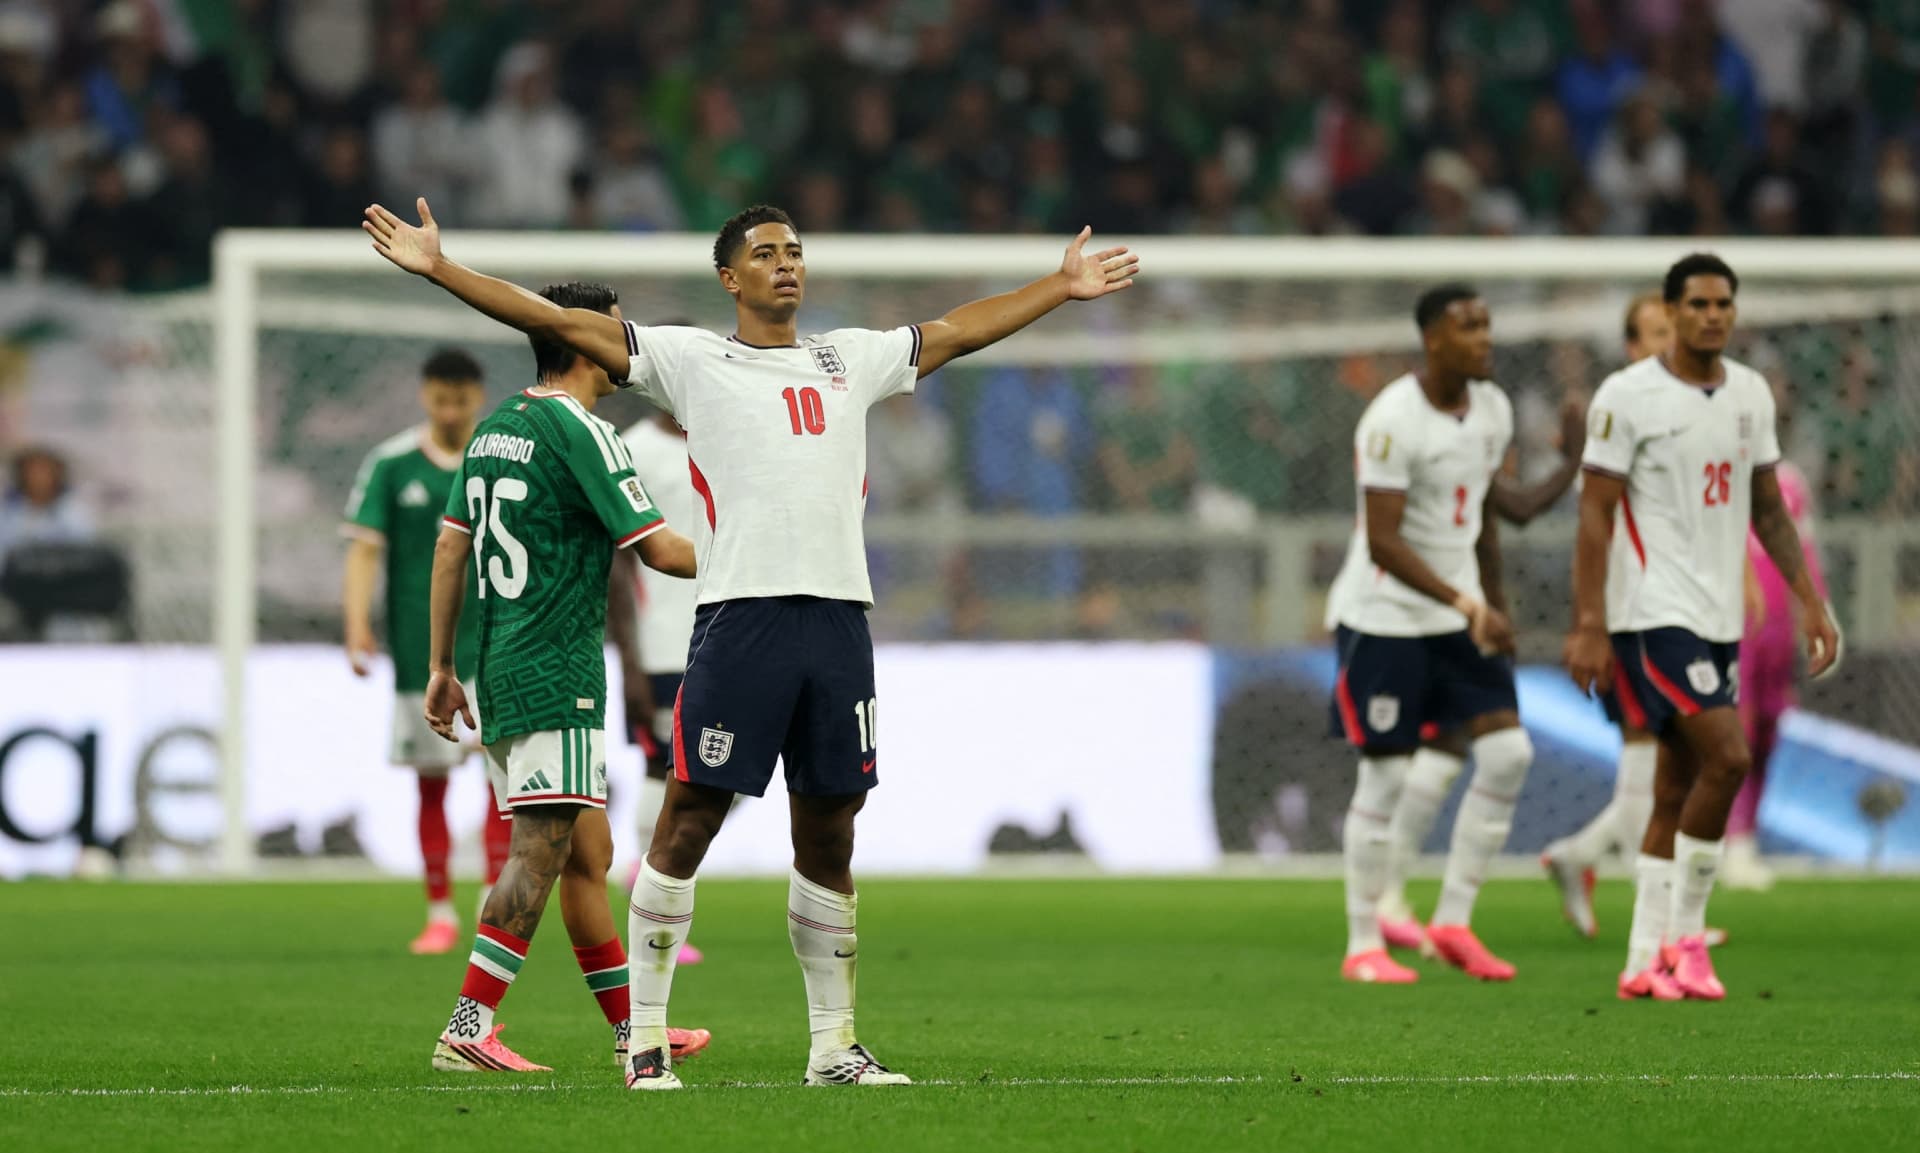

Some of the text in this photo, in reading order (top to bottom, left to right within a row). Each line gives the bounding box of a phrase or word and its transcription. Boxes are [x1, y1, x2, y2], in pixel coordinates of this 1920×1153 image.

[782, 386, 826, 436] 10
[1453, 485, 1468, 528] 2
[1703, 461, 1732, 507] 26
[466, 476, 529, 600] 25
[854, 697, 877, 753] 10
